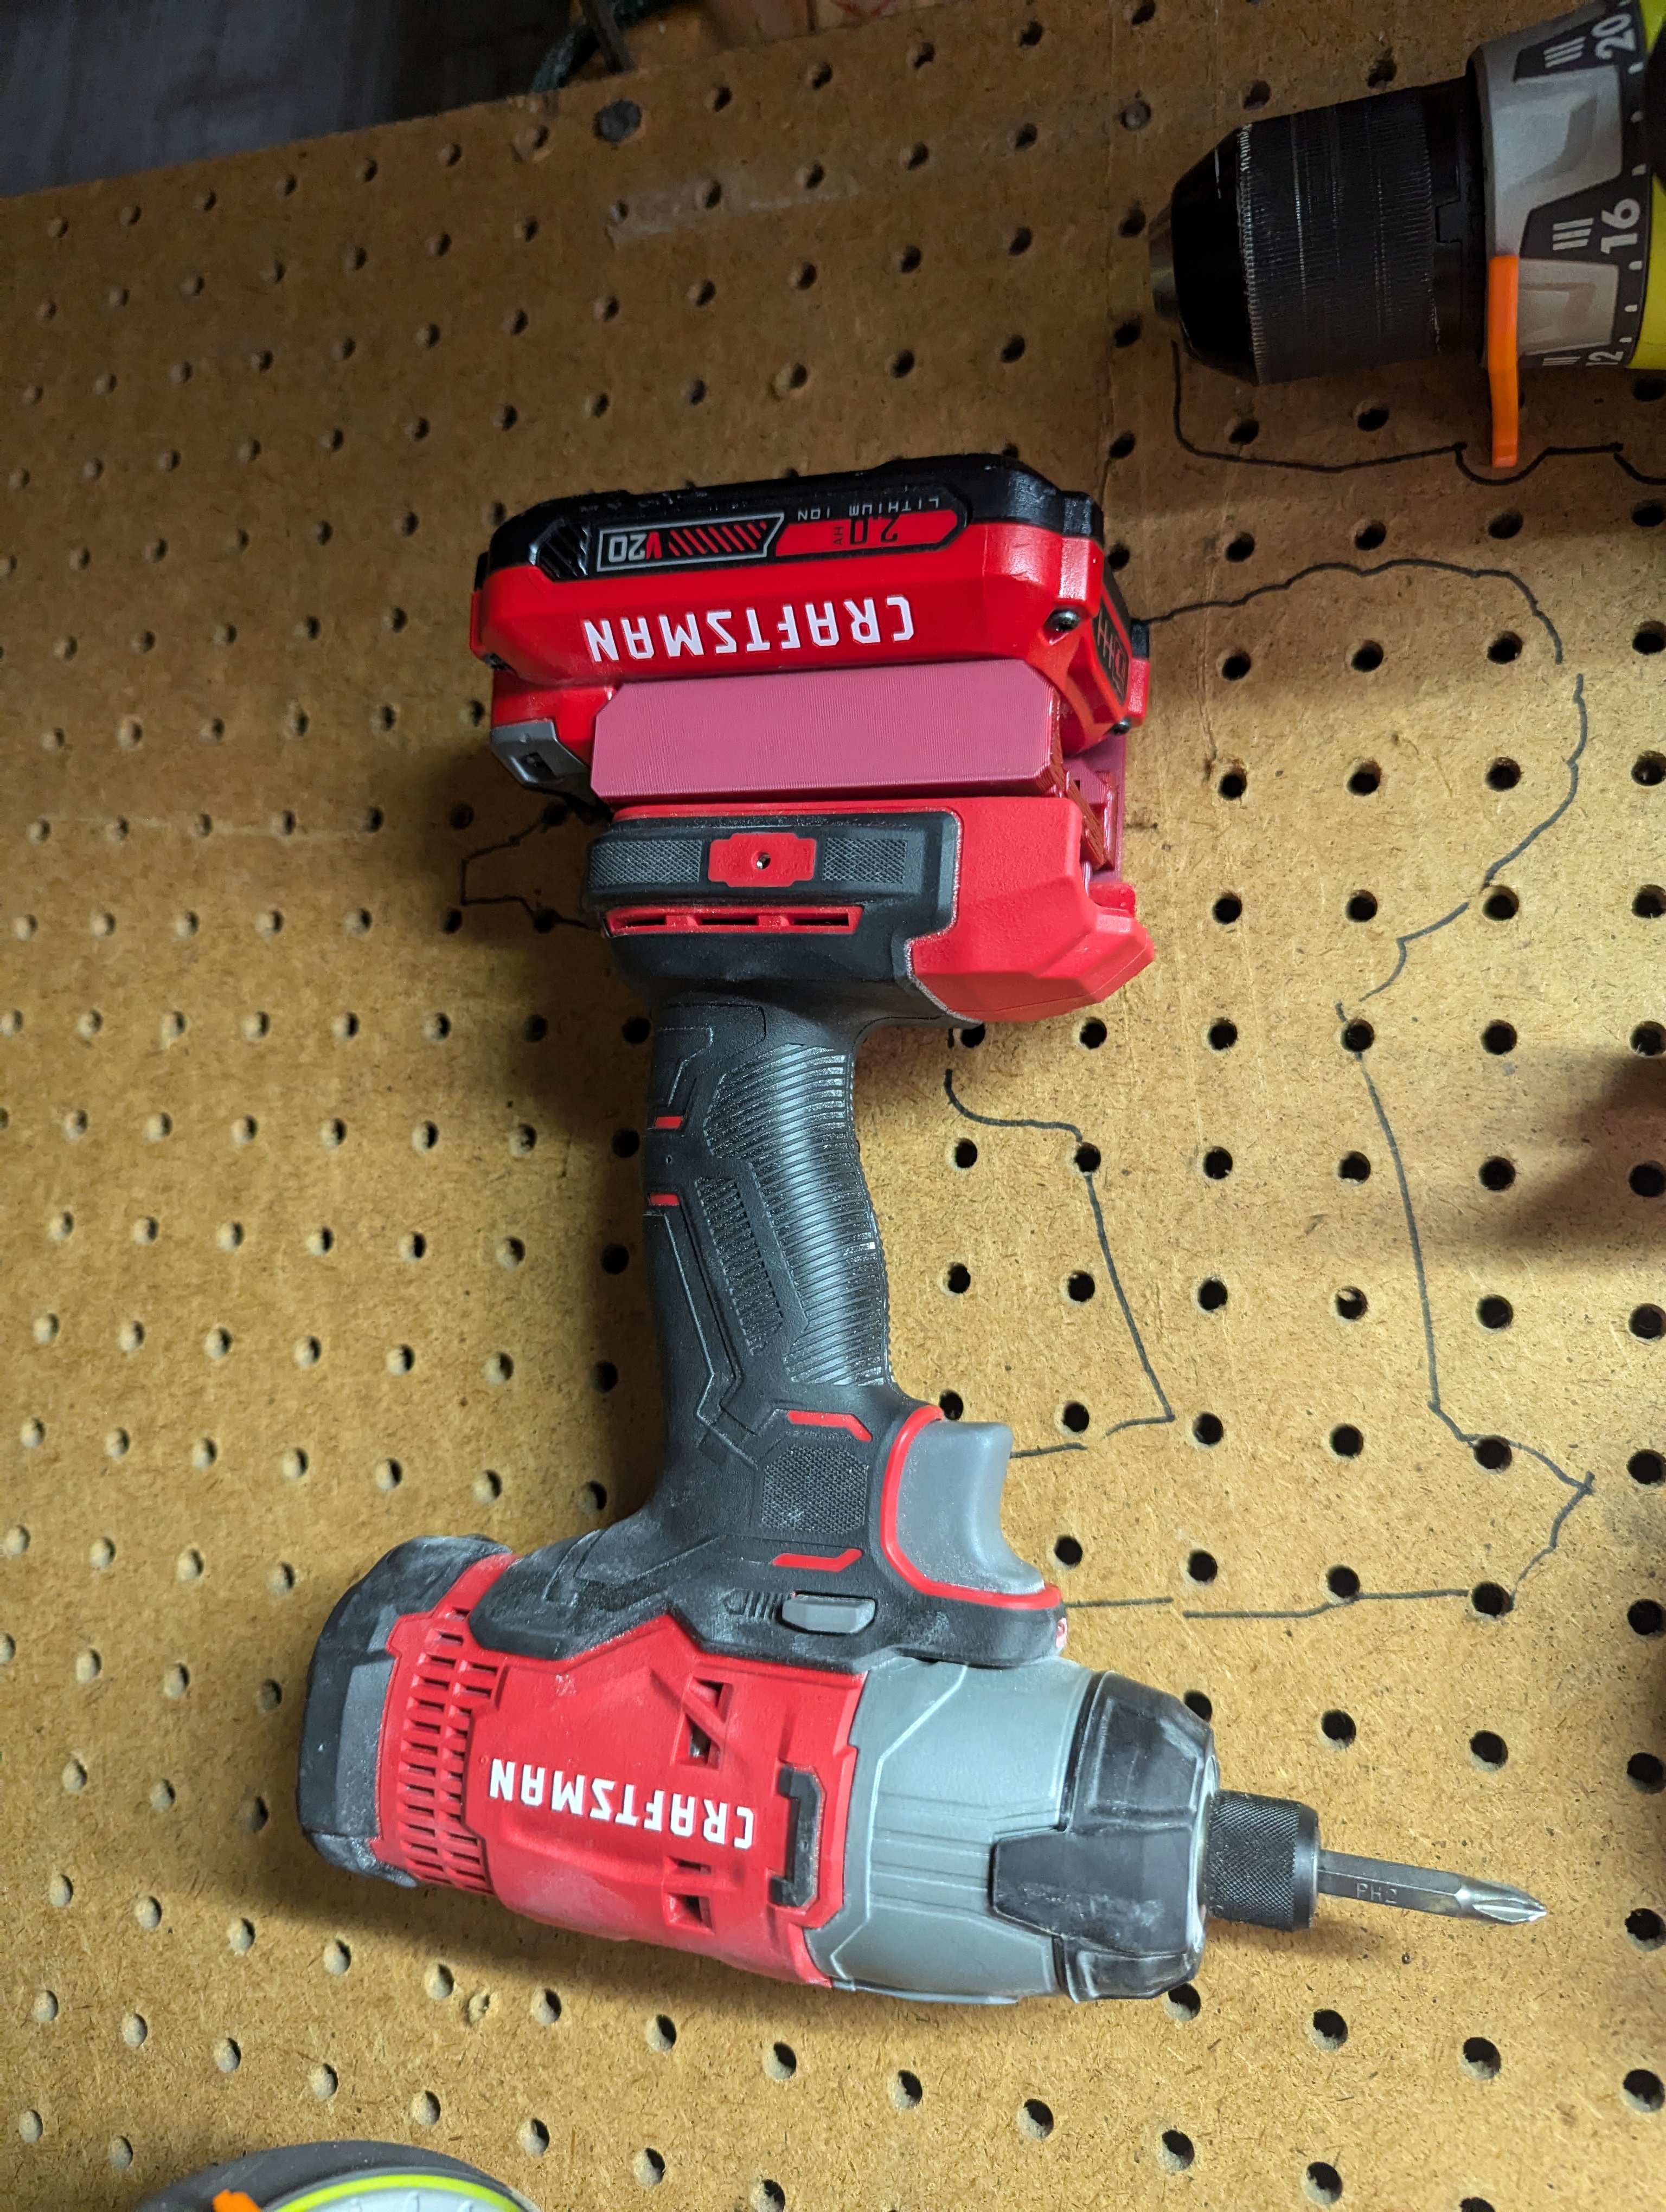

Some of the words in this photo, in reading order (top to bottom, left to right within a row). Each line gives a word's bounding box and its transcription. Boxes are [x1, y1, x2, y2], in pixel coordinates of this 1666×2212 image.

[1591, 14, 1637, 60] 20
[1600, 198, 1641, 254] 16
[1585, 351, 1624, 366] 12
[797, 507, 831, 521] ION
[848, 497, 940, 517] LITHIUM
[833, 526, 844, 546] AH
[848, 515, 899, 545] 2.0
[608, 531, 662, 563] V20
[583, 595, 915, 663] CRAFTSMAN
[489, 1758, 754, 1850] CRAFTSMAN
[1356, 1882, 1398, 1904] PH2
